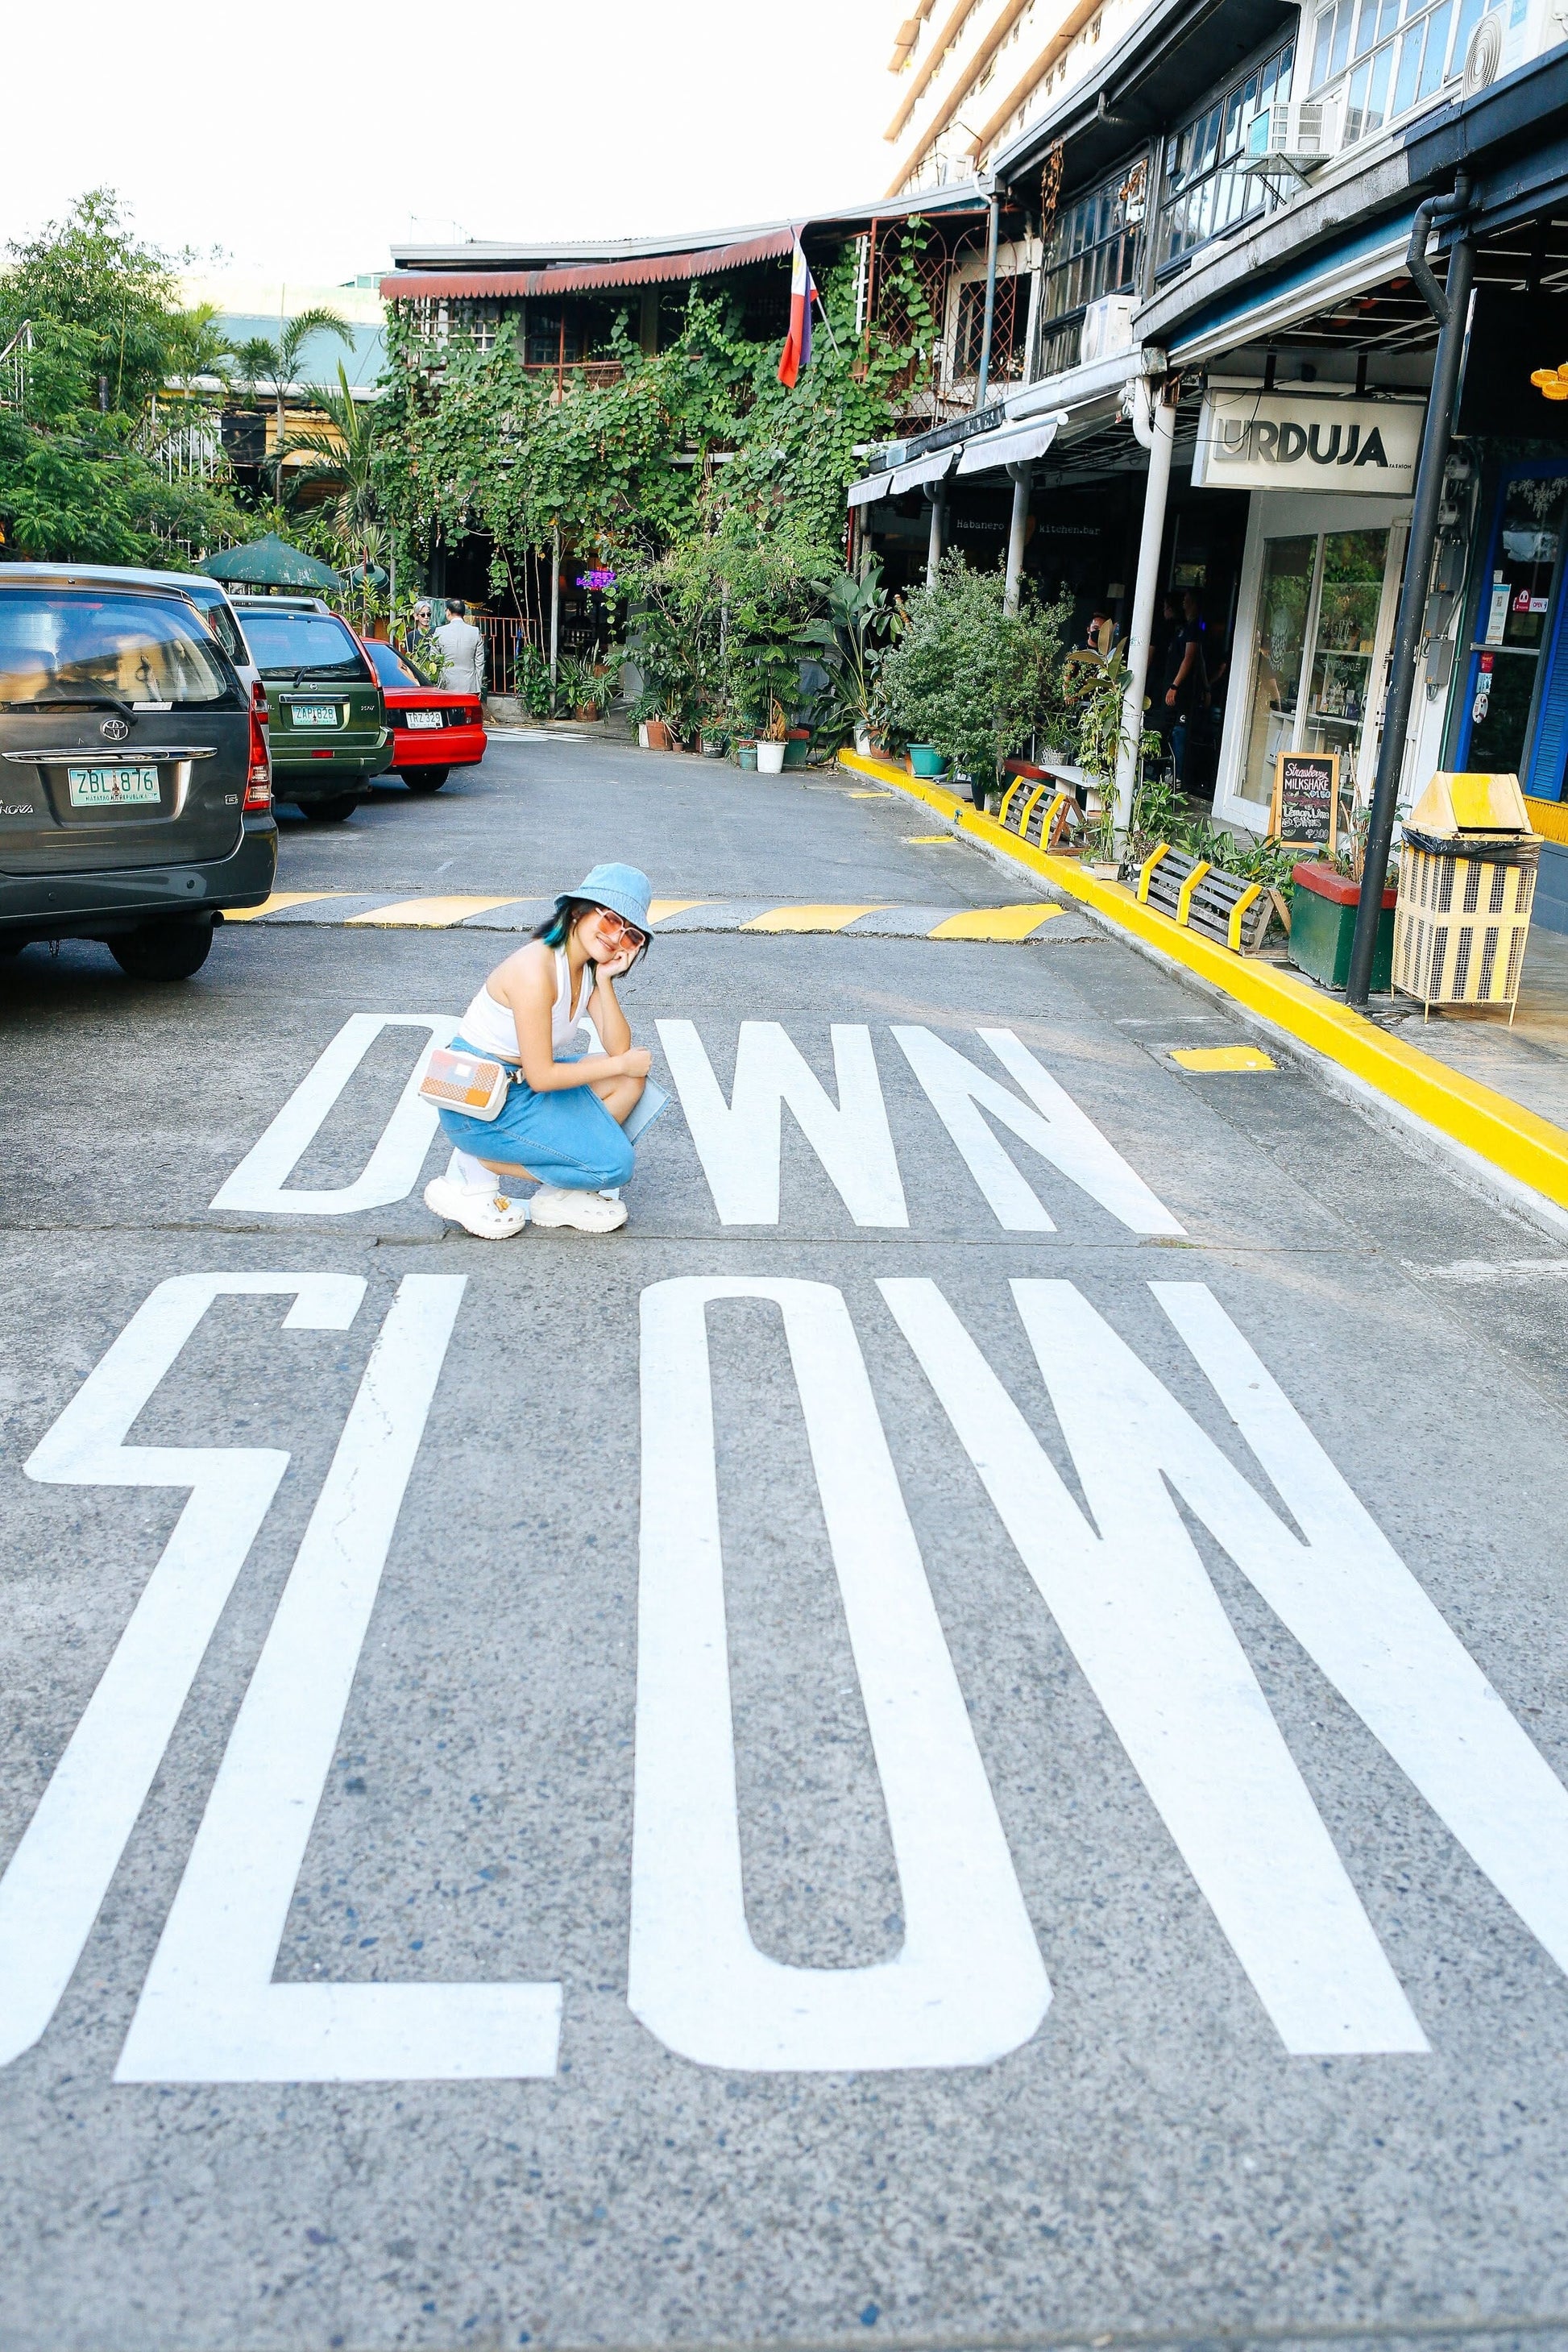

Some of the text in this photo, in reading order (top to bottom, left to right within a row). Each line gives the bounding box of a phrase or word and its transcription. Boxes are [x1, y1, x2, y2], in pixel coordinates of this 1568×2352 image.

[1213, 417, 1389, 468] URDUJA
[956, 519, 1101, 535] Habanero kitchen.bar
[297, 706, 334, 720] ZAP 828
[408, 712, 442, 724] TRZ 329
[77, 771, 154, 794] ZBL 876
[1284, 778, 1329, 791] MILKSHAKE
[208, 1013, 1187, 1237] DWN
[0, 1271, 1568, 2083] SLOW
